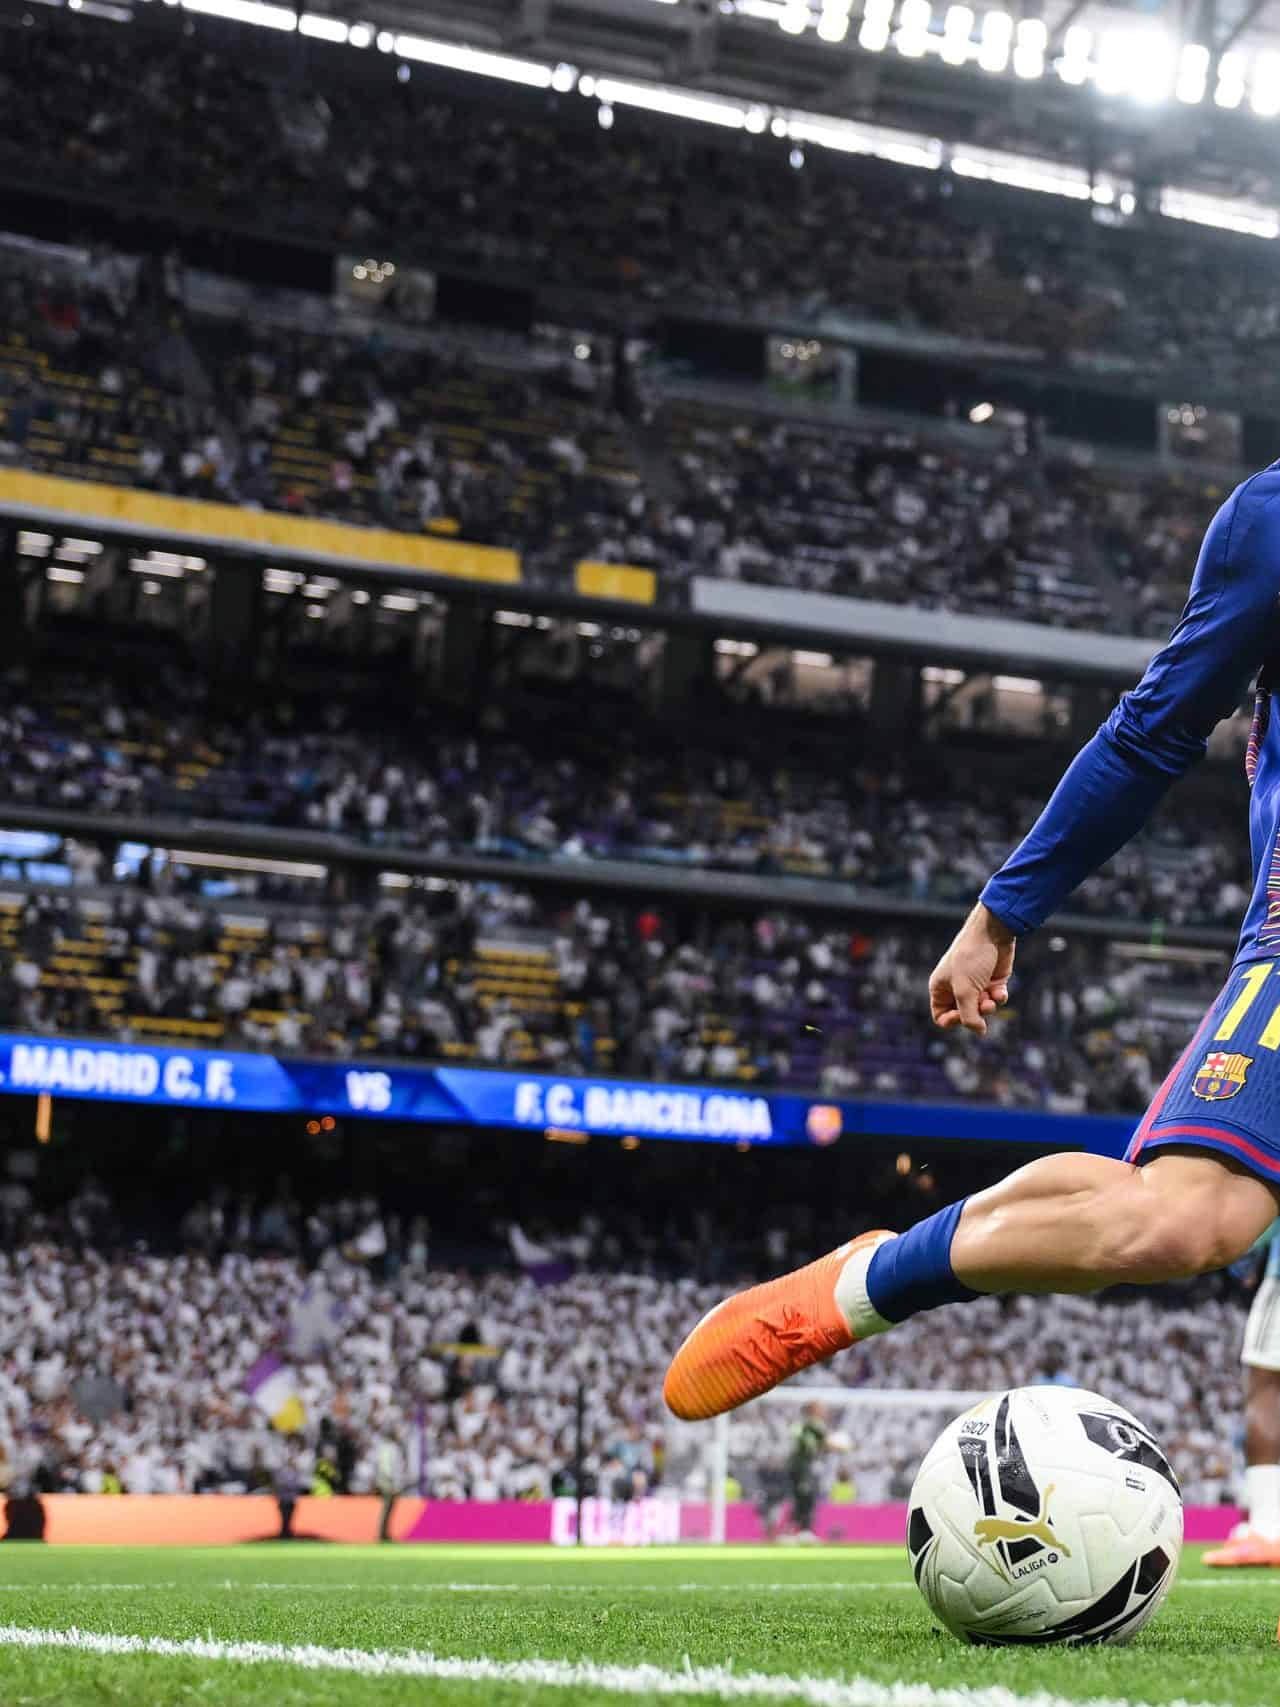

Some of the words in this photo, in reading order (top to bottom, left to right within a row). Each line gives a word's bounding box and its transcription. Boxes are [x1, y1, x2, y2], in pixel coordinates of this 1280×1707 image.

[10, 1044, 160, 1096] MADRID
[346, 1071, 392, 1111] VS
[583, 1086, 773, 1140] BARCELONA
[1012, 1558, 1047, 1579] LALIGA
